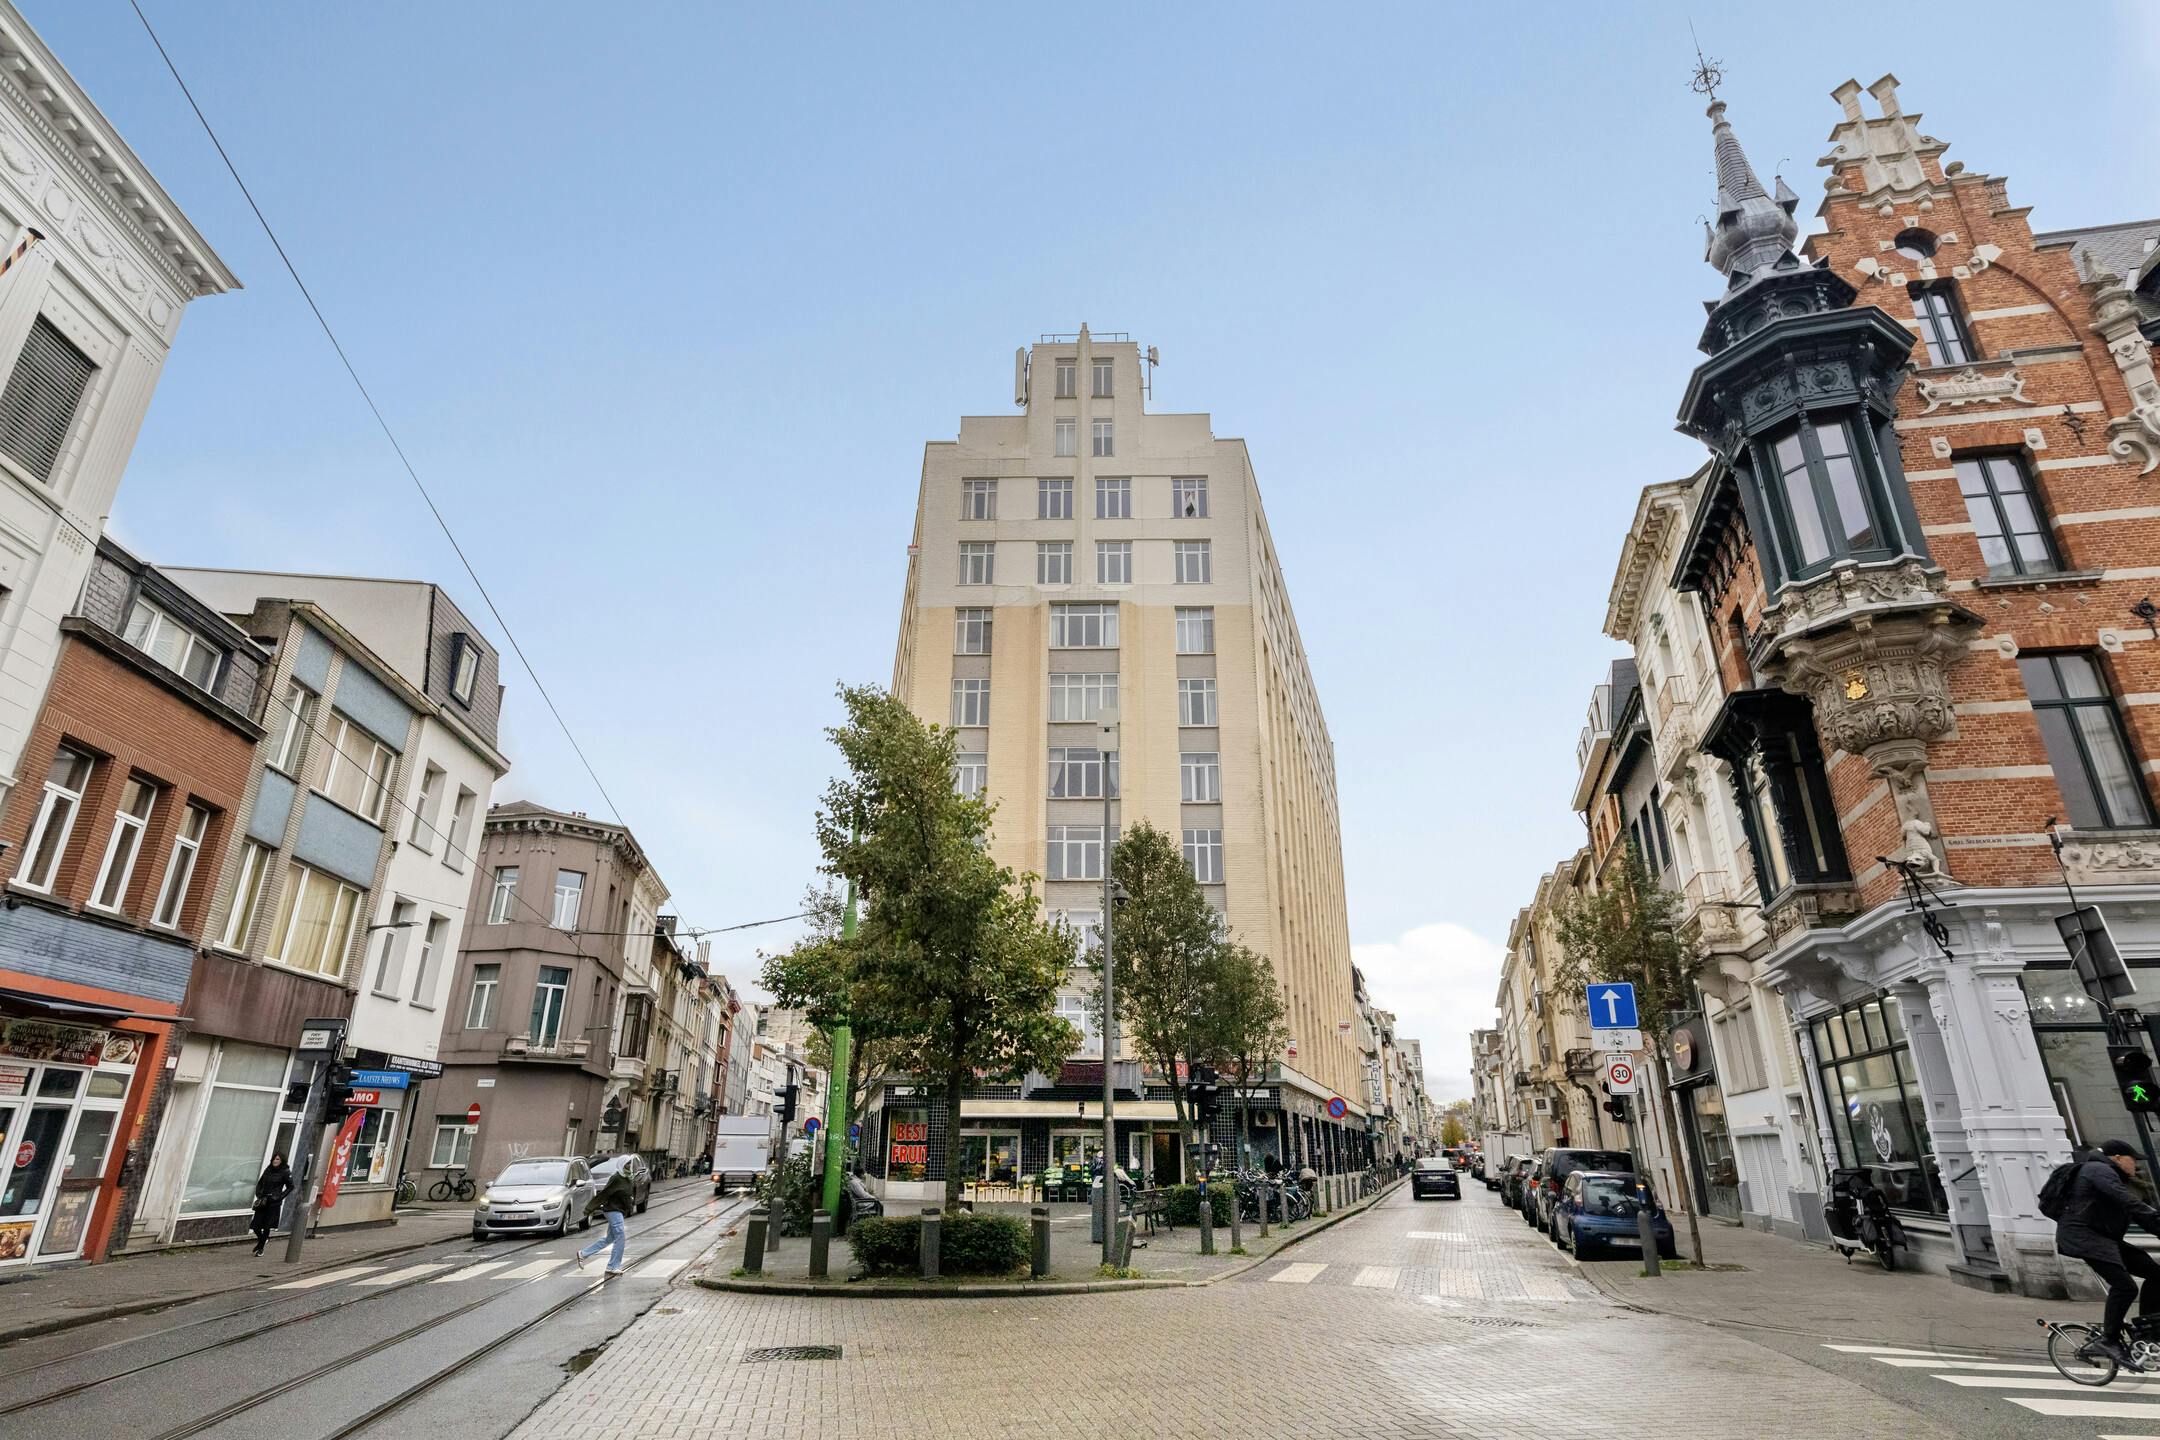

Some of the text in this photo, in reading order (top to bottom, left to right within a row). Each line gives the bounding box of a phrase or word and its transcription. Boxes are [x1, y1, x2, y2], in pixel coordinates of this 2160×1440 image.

[1372, 1061, 1381, 1104] FRITUUR
[1615, 1069, 1629, 1079] 30
[345, 1092, 374, 1102] UMO
[896, 1122, 928, 1142] BEST
[891, 1144, 928, 1164] FRUIT
